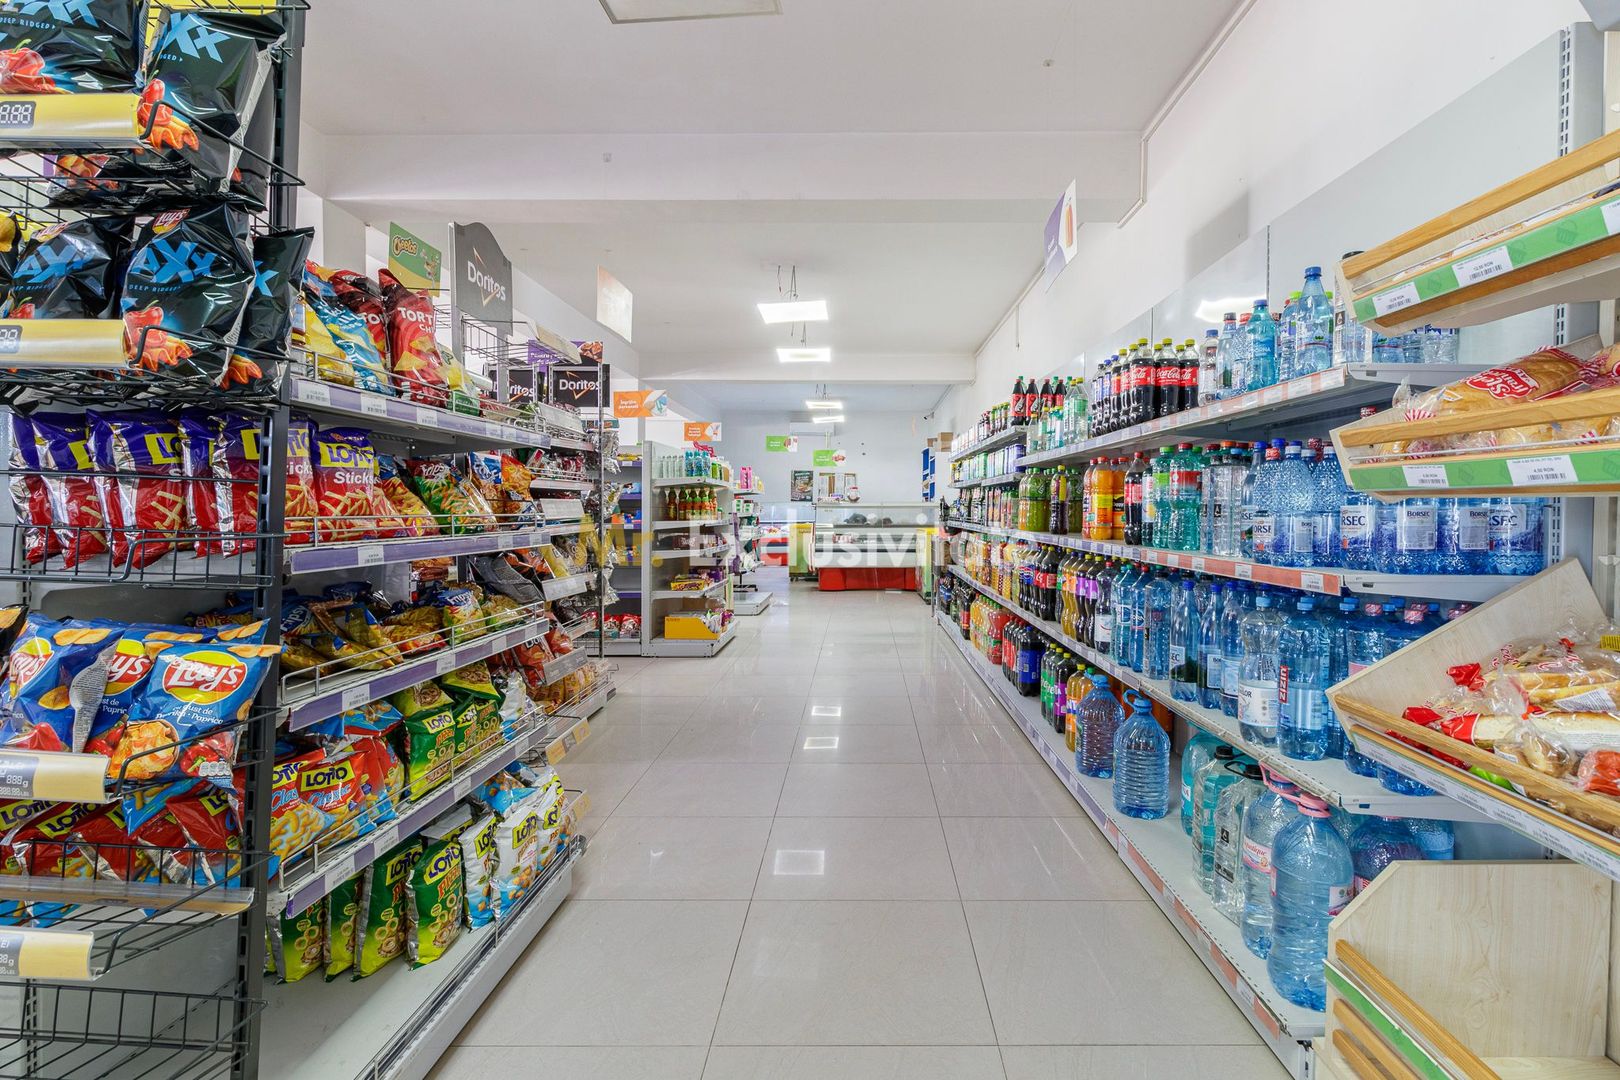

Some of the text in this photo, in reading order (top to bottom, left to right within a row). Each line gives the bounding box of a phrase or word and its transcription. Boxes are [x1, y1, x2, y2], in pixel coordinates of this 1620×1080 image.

[393, 235, 418, 256] Cheetos
[467, 260, 506, 301] Doritos
[167, 659, 239, 691] Lay's
[305, 767, 348, 788] LOTTO
